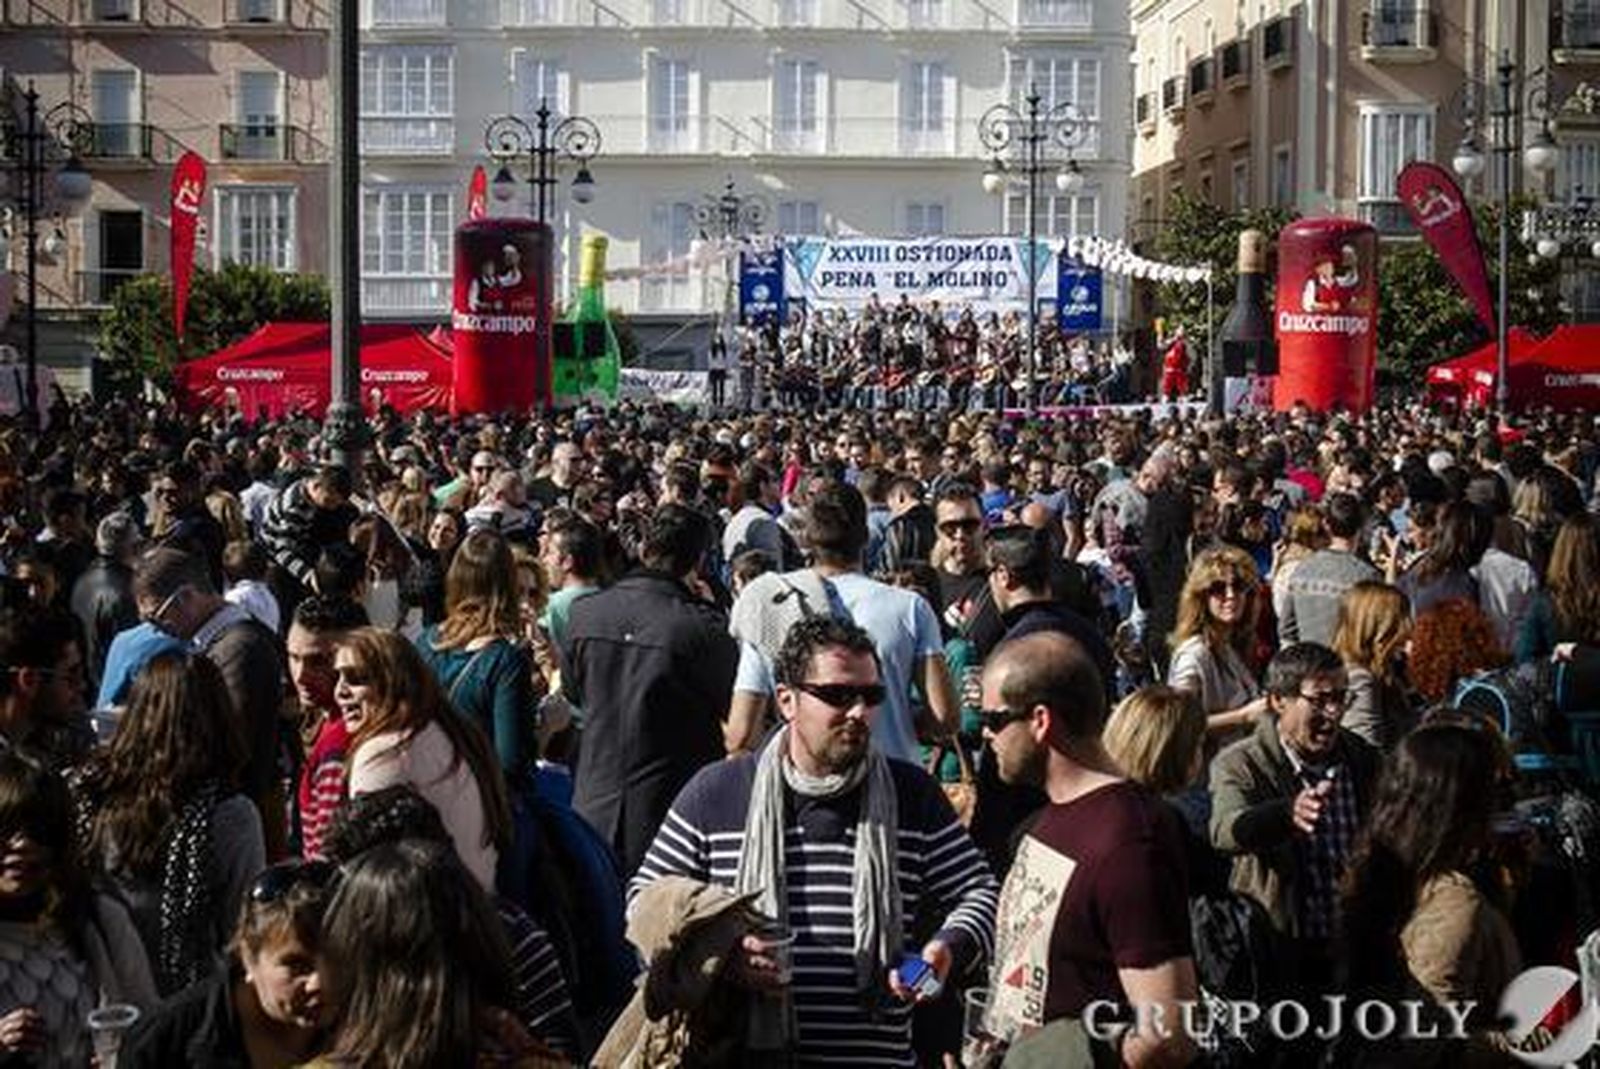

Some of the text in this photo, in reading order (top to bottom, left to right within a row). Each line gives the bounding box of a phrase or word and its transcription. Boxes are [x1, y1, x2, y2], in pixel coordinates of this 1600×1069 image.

[828, 245, 1013, 262] XXVIII OSTIONADA
[216, 367, 285, 381] Cruzcampo
[361, 368, 430, 382] Cruzcampo
